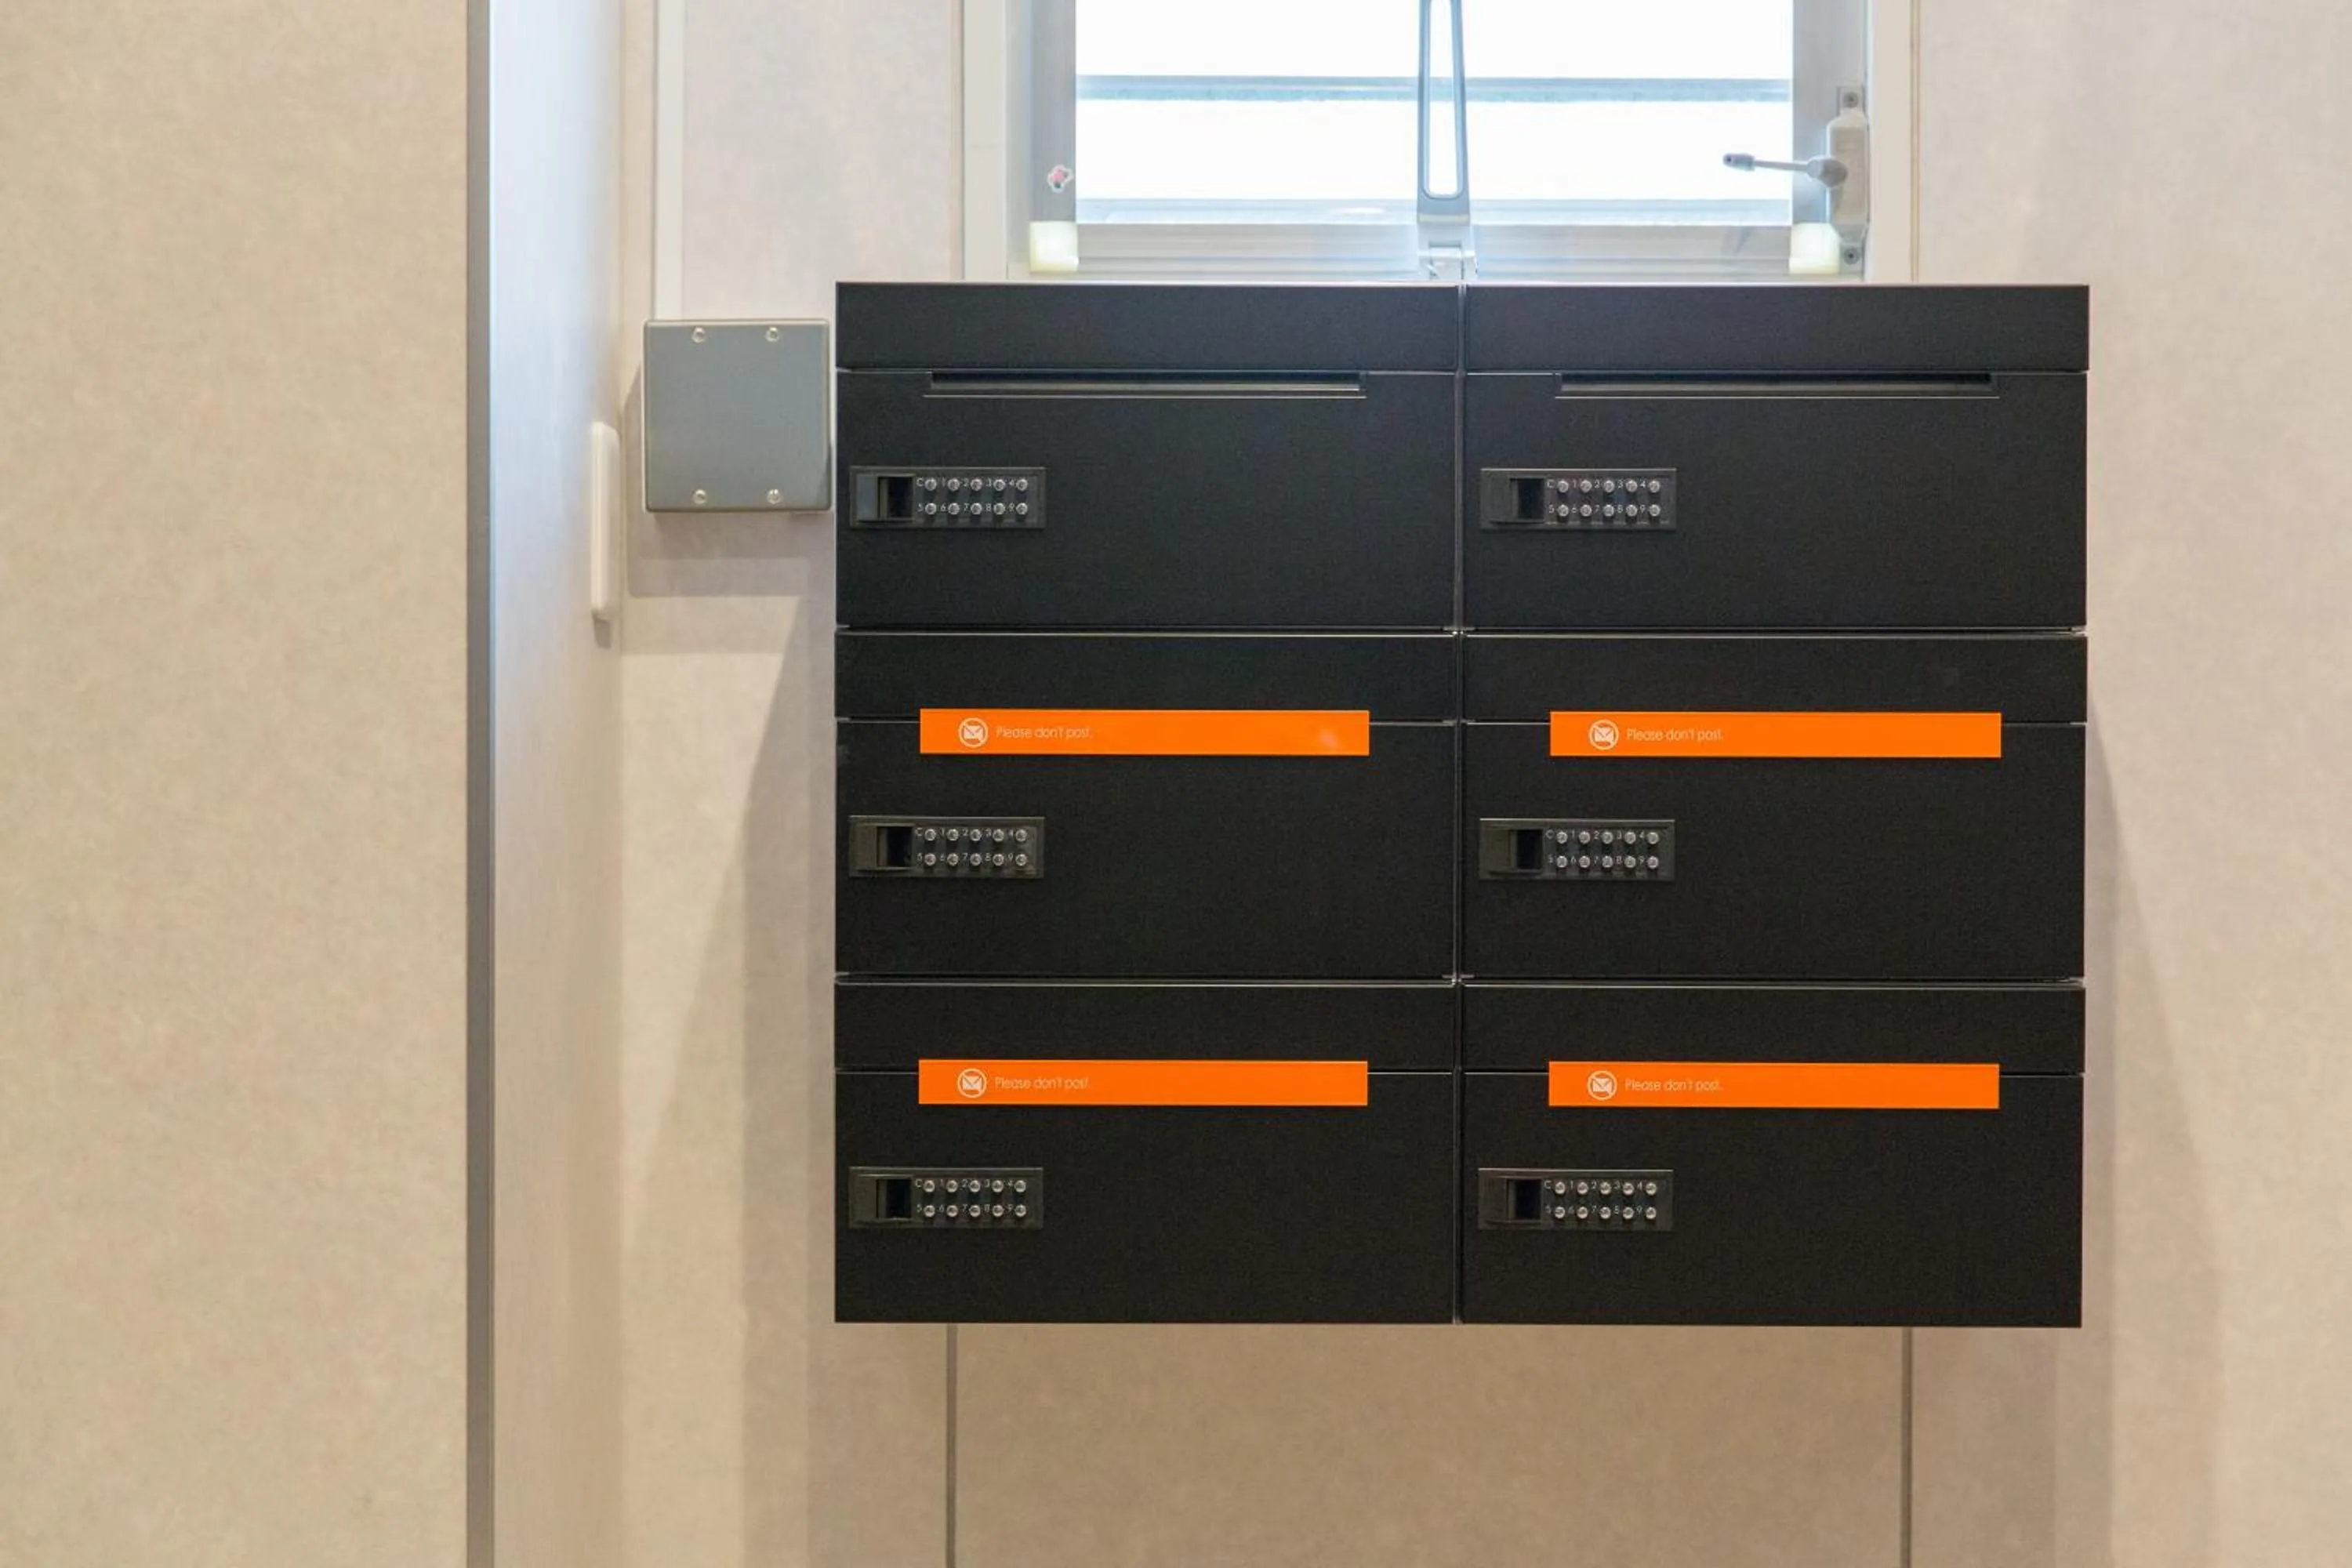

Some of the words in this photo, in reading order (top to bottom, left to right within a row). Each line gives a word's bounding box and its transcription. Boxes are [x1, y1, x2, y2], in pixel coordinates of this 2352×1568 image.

[996, 726, 1032, 739] Please
[1034, 726, 1063, 739] don't
[1627, 728, 1663, 741] Please
[1666, 728, 1694, 741] don't
[995, 1076, 1031, 1089] Please
[1034, 1076, 1063, 1089] don't
[1624, 1079, 1661, 1091] Please
[1664, 1079, 1693, 1091] don't
